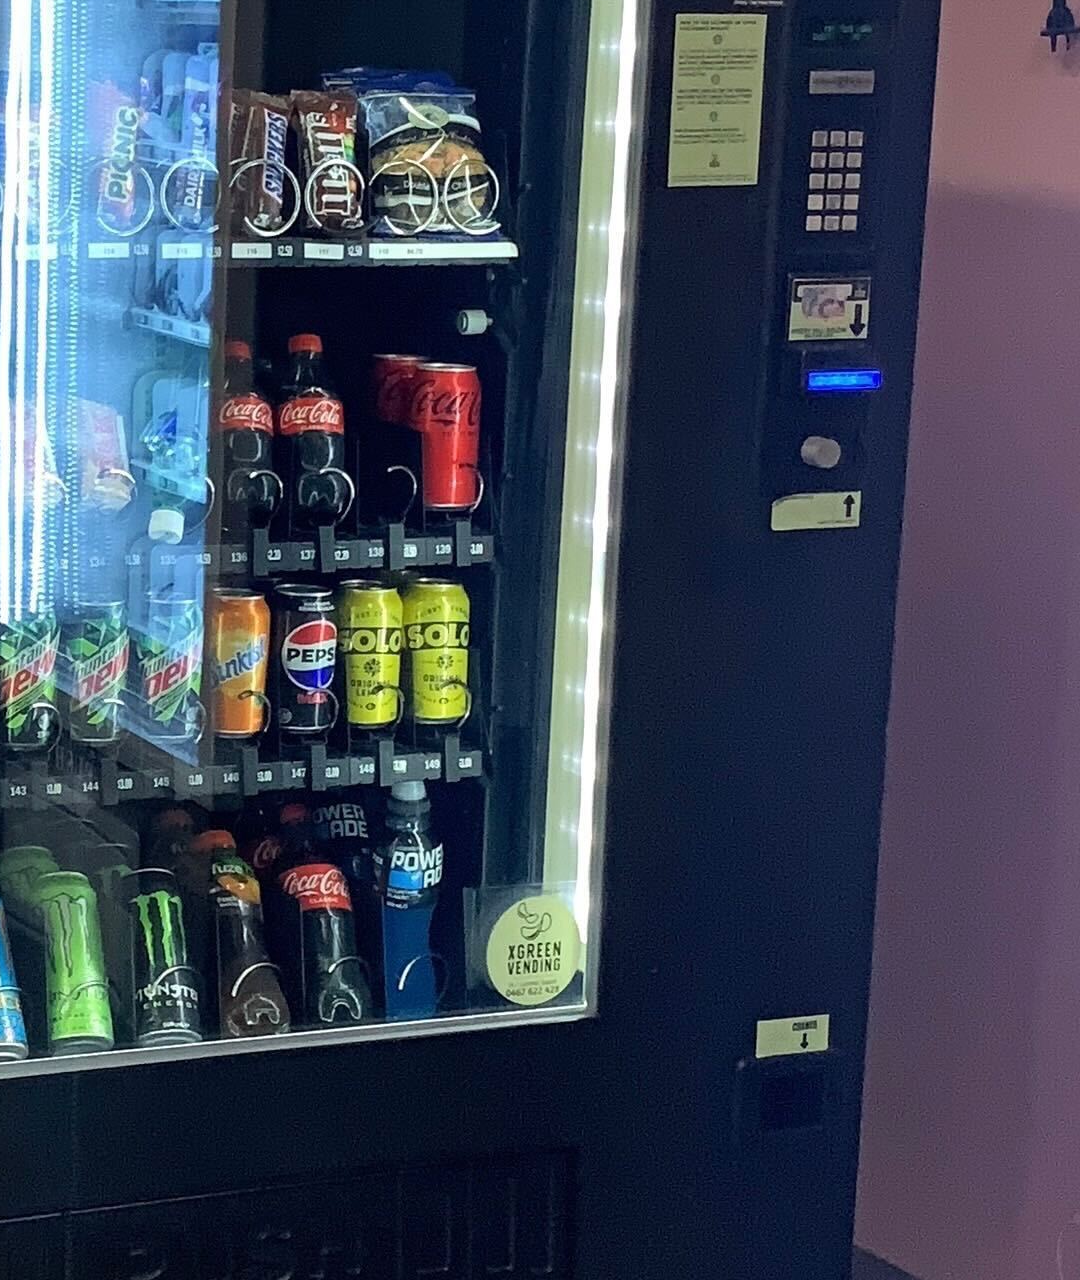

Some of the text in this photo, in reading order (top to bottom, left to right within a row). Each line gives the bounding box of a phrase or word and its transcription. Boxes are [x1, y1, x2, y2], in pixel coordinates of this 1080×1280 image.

[300, 550, 316, 561] 137
[340, 629, 401, 652] SOLO
[408, 623, 469, 648] SOLO
[287, 647, 334, 663] PEPS
[291, 768, 306, 778] 147
[82, 782, 99, 792] 144
[153, 777, 169, 787] 145
[10, 786, 27, 796] 143
[330, 819, 369, 839] ADE
[508, 941, 561, 960] XGREEN
[508, 958, 561, 975] VENDING
